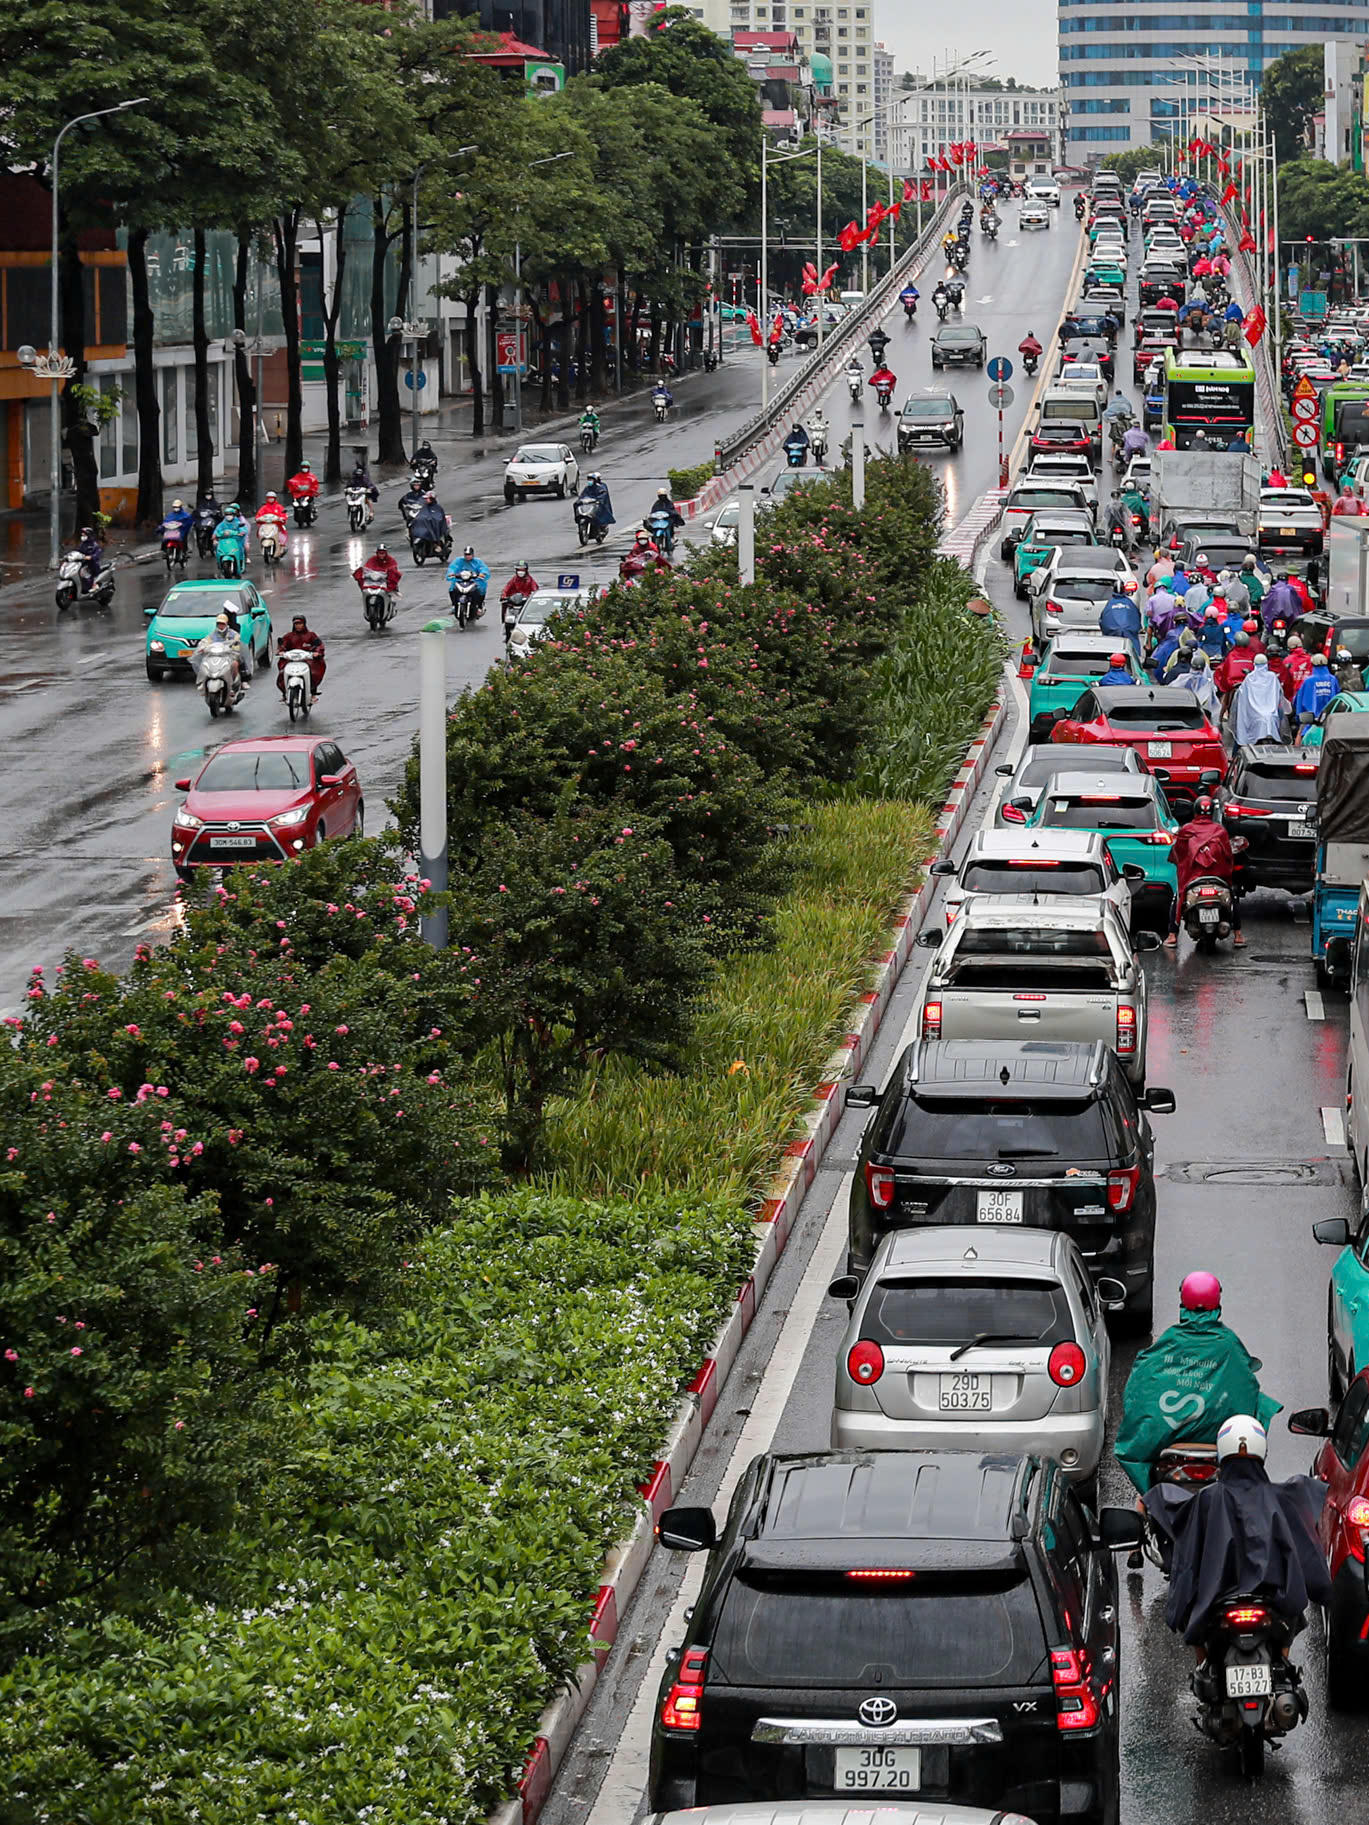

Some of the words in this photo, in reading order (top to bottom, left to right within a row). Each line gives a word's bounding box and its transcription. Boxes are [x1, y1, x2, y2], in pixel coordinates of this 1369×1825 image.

[1335, 909, 1360, 917] THAC
[988, 1193, 1013, 1207] 30F
[979, 1207, 1021, 1222] 656.84
[952, 1374, 979, 1391] 29D
[941, 1392, 990, 1409] 503.75
[1233, 1667, 1264, 1681] 17-B3
[1230, 1679, 1268, 1695] 563.27
[1012, 1701, 1038, 1713] VX
[860, 1750, 896, 1767] 30G
[844, 1771, 911, 1788] 997.20
